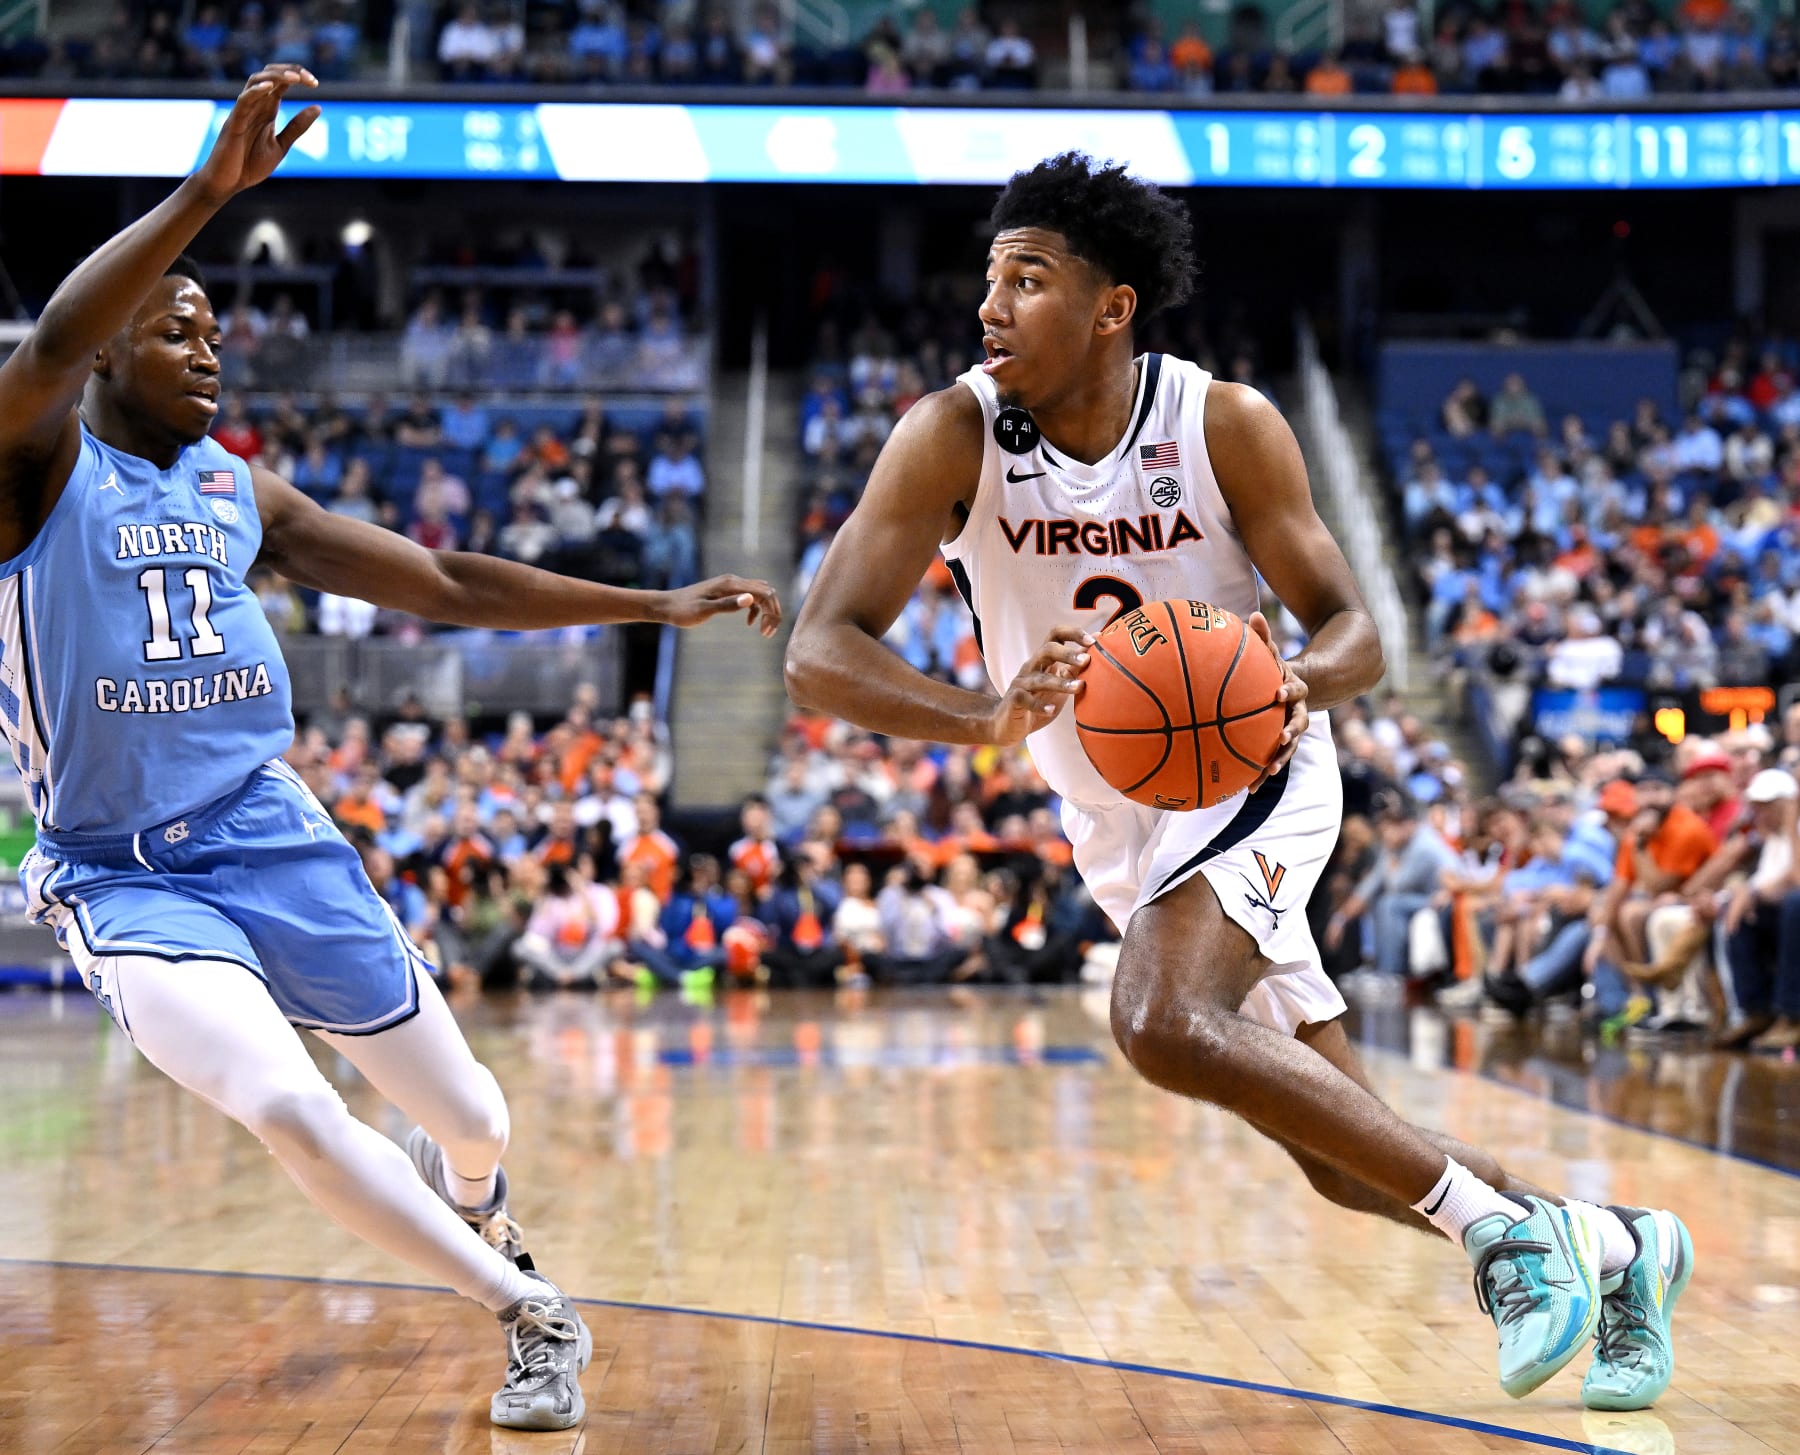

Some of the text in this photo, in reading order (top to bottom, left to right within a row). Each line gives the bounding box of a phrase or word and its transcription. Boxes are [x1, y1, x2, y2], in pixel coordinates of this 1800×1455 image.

[344, 115, 412, 162] 1ST
[1204, 122, 1230, 176] 1
[1347, 124, 1387, 178] 2
[1634, 126, 1688, 178] 11
[1002, 419, 1031, 433] 15 41
[116, 522, 229, 567] NORTH
[997, 509, 1204, 557] VIRGINIA
[138, 566, 225, 662] 11
[95, 662, 273, 713] CAROLINA
